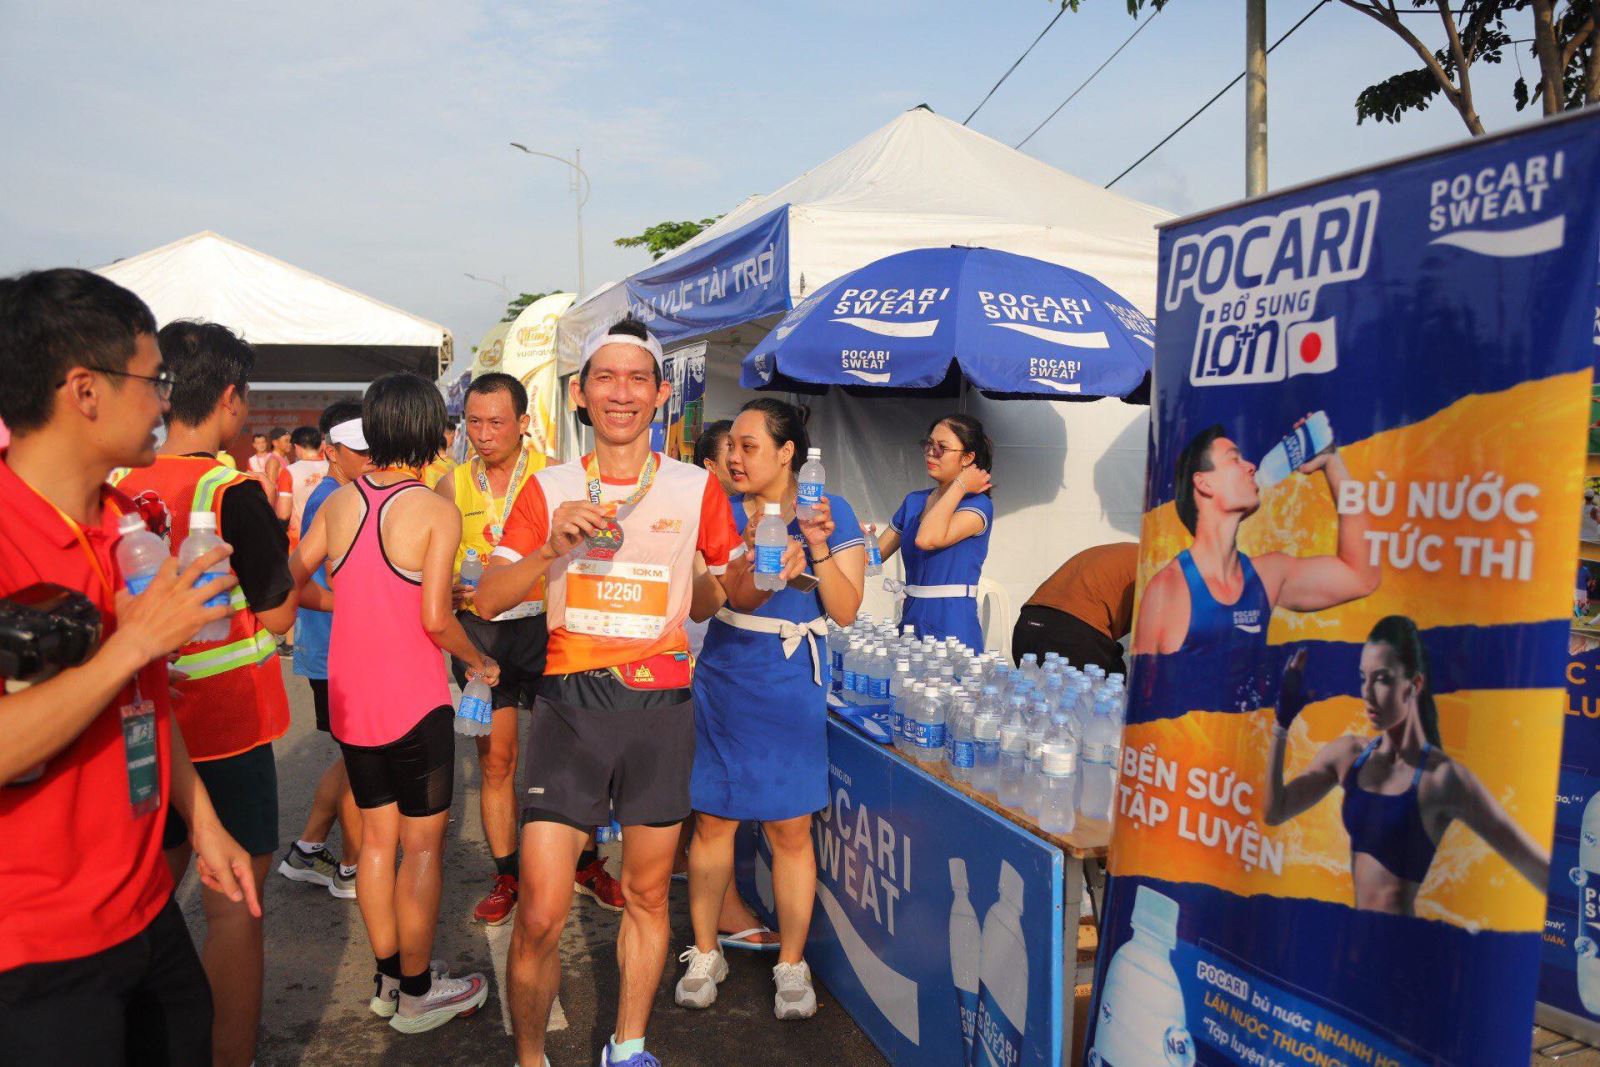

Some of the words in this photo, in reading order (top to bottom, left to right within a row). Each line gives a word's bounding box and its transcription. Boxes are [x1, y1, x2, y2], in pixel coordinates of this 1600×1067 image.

[1430, 150, 1564, 206] POCARI
[1429, 181, 1548, 232] SWEAT
[1168, 200, 1371, 303] POCARI
[698, 266, 727, 304] TÀI
[732, 243, 774, 292] TRỢ
[834, 301, 935, 315] SWEAT
[841, 288, 950, 301] POCARI
[978, 291, 1092, 312] POCARI
[1254, 290, 1310, 318] SUNG
[984, 304, 1084, 325] SWEAT
[841, 350, 890, 361] POCARI
[841, 359, 885, 369] SWEAT
[1029, 367, 1076, 379] SWEAT
[1030, 357, 1081, 371] POCARI
[1337, 471, 1396, 516] BÙ
[1407, 471, 1541, 524] NƯỚC
[1364, 523, 1444, 572] TỨC
[1454, 529, 1534, 580] THÌ
[597, 581, 642, 602] 12250
[1122, 743, 1178, 792] BỀN
[1186, 766, 1253, 816] SỨC
[1119, 784, 1169, 830] TẬP
[1177, 806, 1284, 876] LUYỆN
[816, 819, 900, 936] WEAT
[1197, 961, 1248, 1000] POCARI
[1314, 1020, 1373, 1063] NHANH
